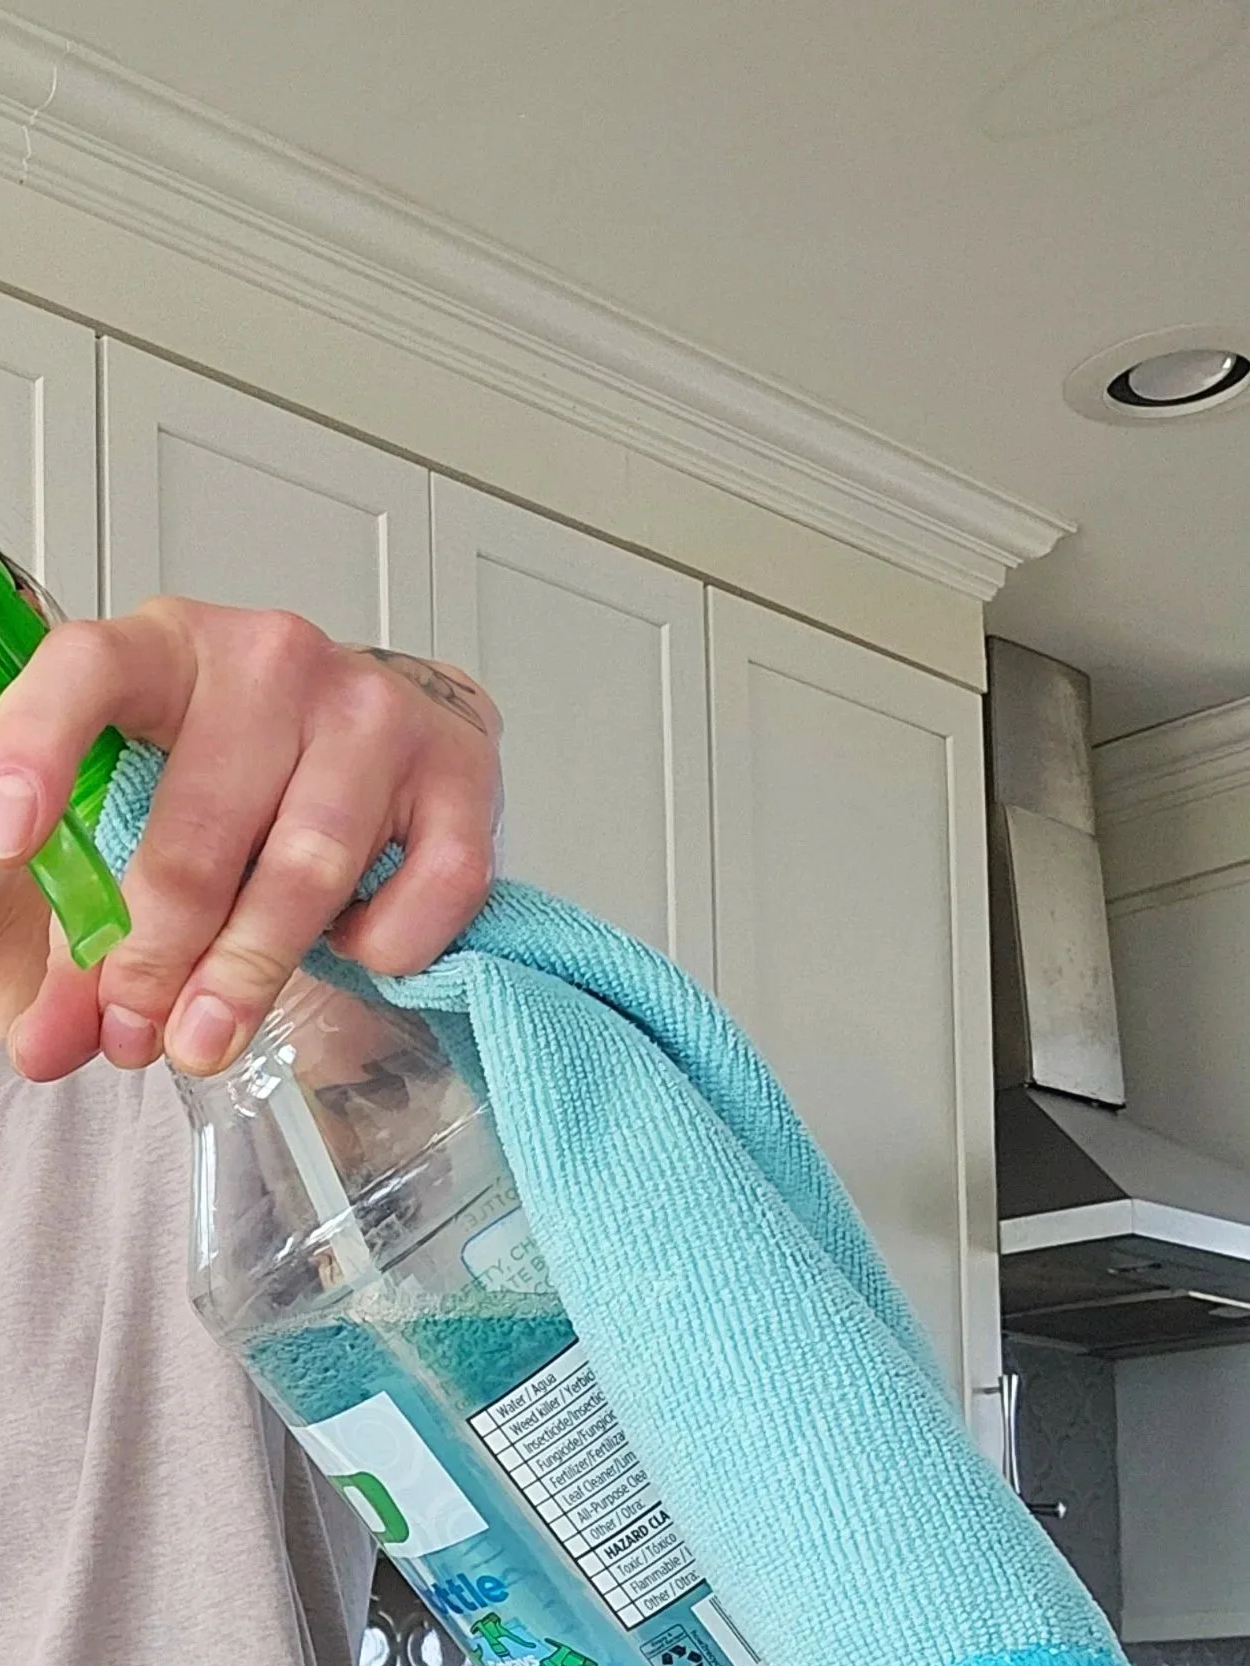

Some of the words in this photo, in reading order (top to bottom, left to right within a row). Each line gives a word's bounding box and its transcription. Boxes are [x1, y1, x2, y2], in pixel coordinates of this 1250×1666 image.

[496, 1394, 527, 1418] Water
[532, 1373, 557, 1396] Agua
[509, 1410, 539, 1436] Weed
[536, 1396, 561, 1418] killer
[562, 1485, 584, 1506] Leaf
[576, 1483, 630, 1524] All-Purpose
[626, 1469, 648, 1488] Clea
[590, 1517, 616, 1540] Other
[621, 1498, 646, 1520] Otra:
[603, 1524, 649, 1559] HAZARD
[649, 1509, 671, 1530] CLA
[617, 1554, 644, 1577] Toxic
[648, 1532, 677, 1559] Tóxico
[629, 1556, 680, 1594] Flammable
[644, 1588, 670, 1611] Other
[675, 1569, 701, 1591] Otra:
